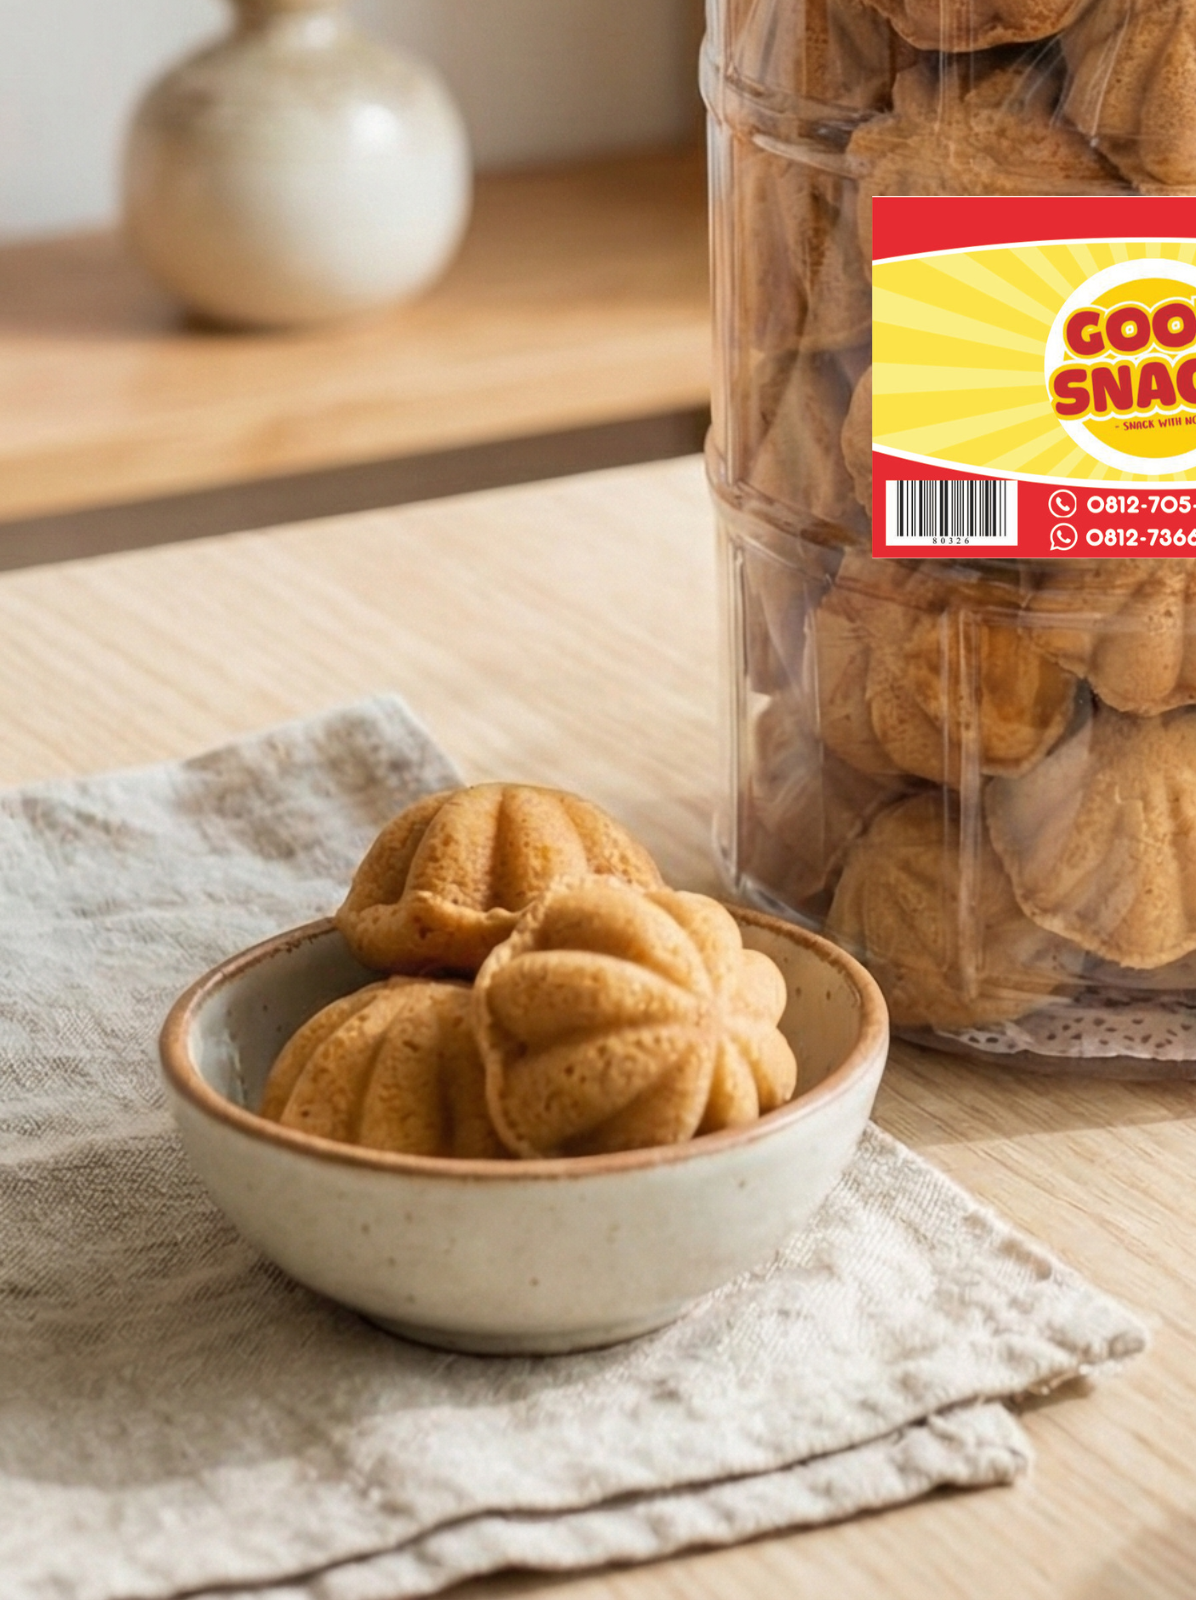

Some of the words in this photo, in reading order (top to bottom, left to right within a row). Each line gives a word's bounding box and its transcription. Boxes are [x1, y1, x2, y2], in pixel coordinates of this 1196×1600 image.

[1123, 420, 1155, 431] SNACK
[1158, 416, 1182, 428] WITH
[932, 537, 970, 545] 80326
